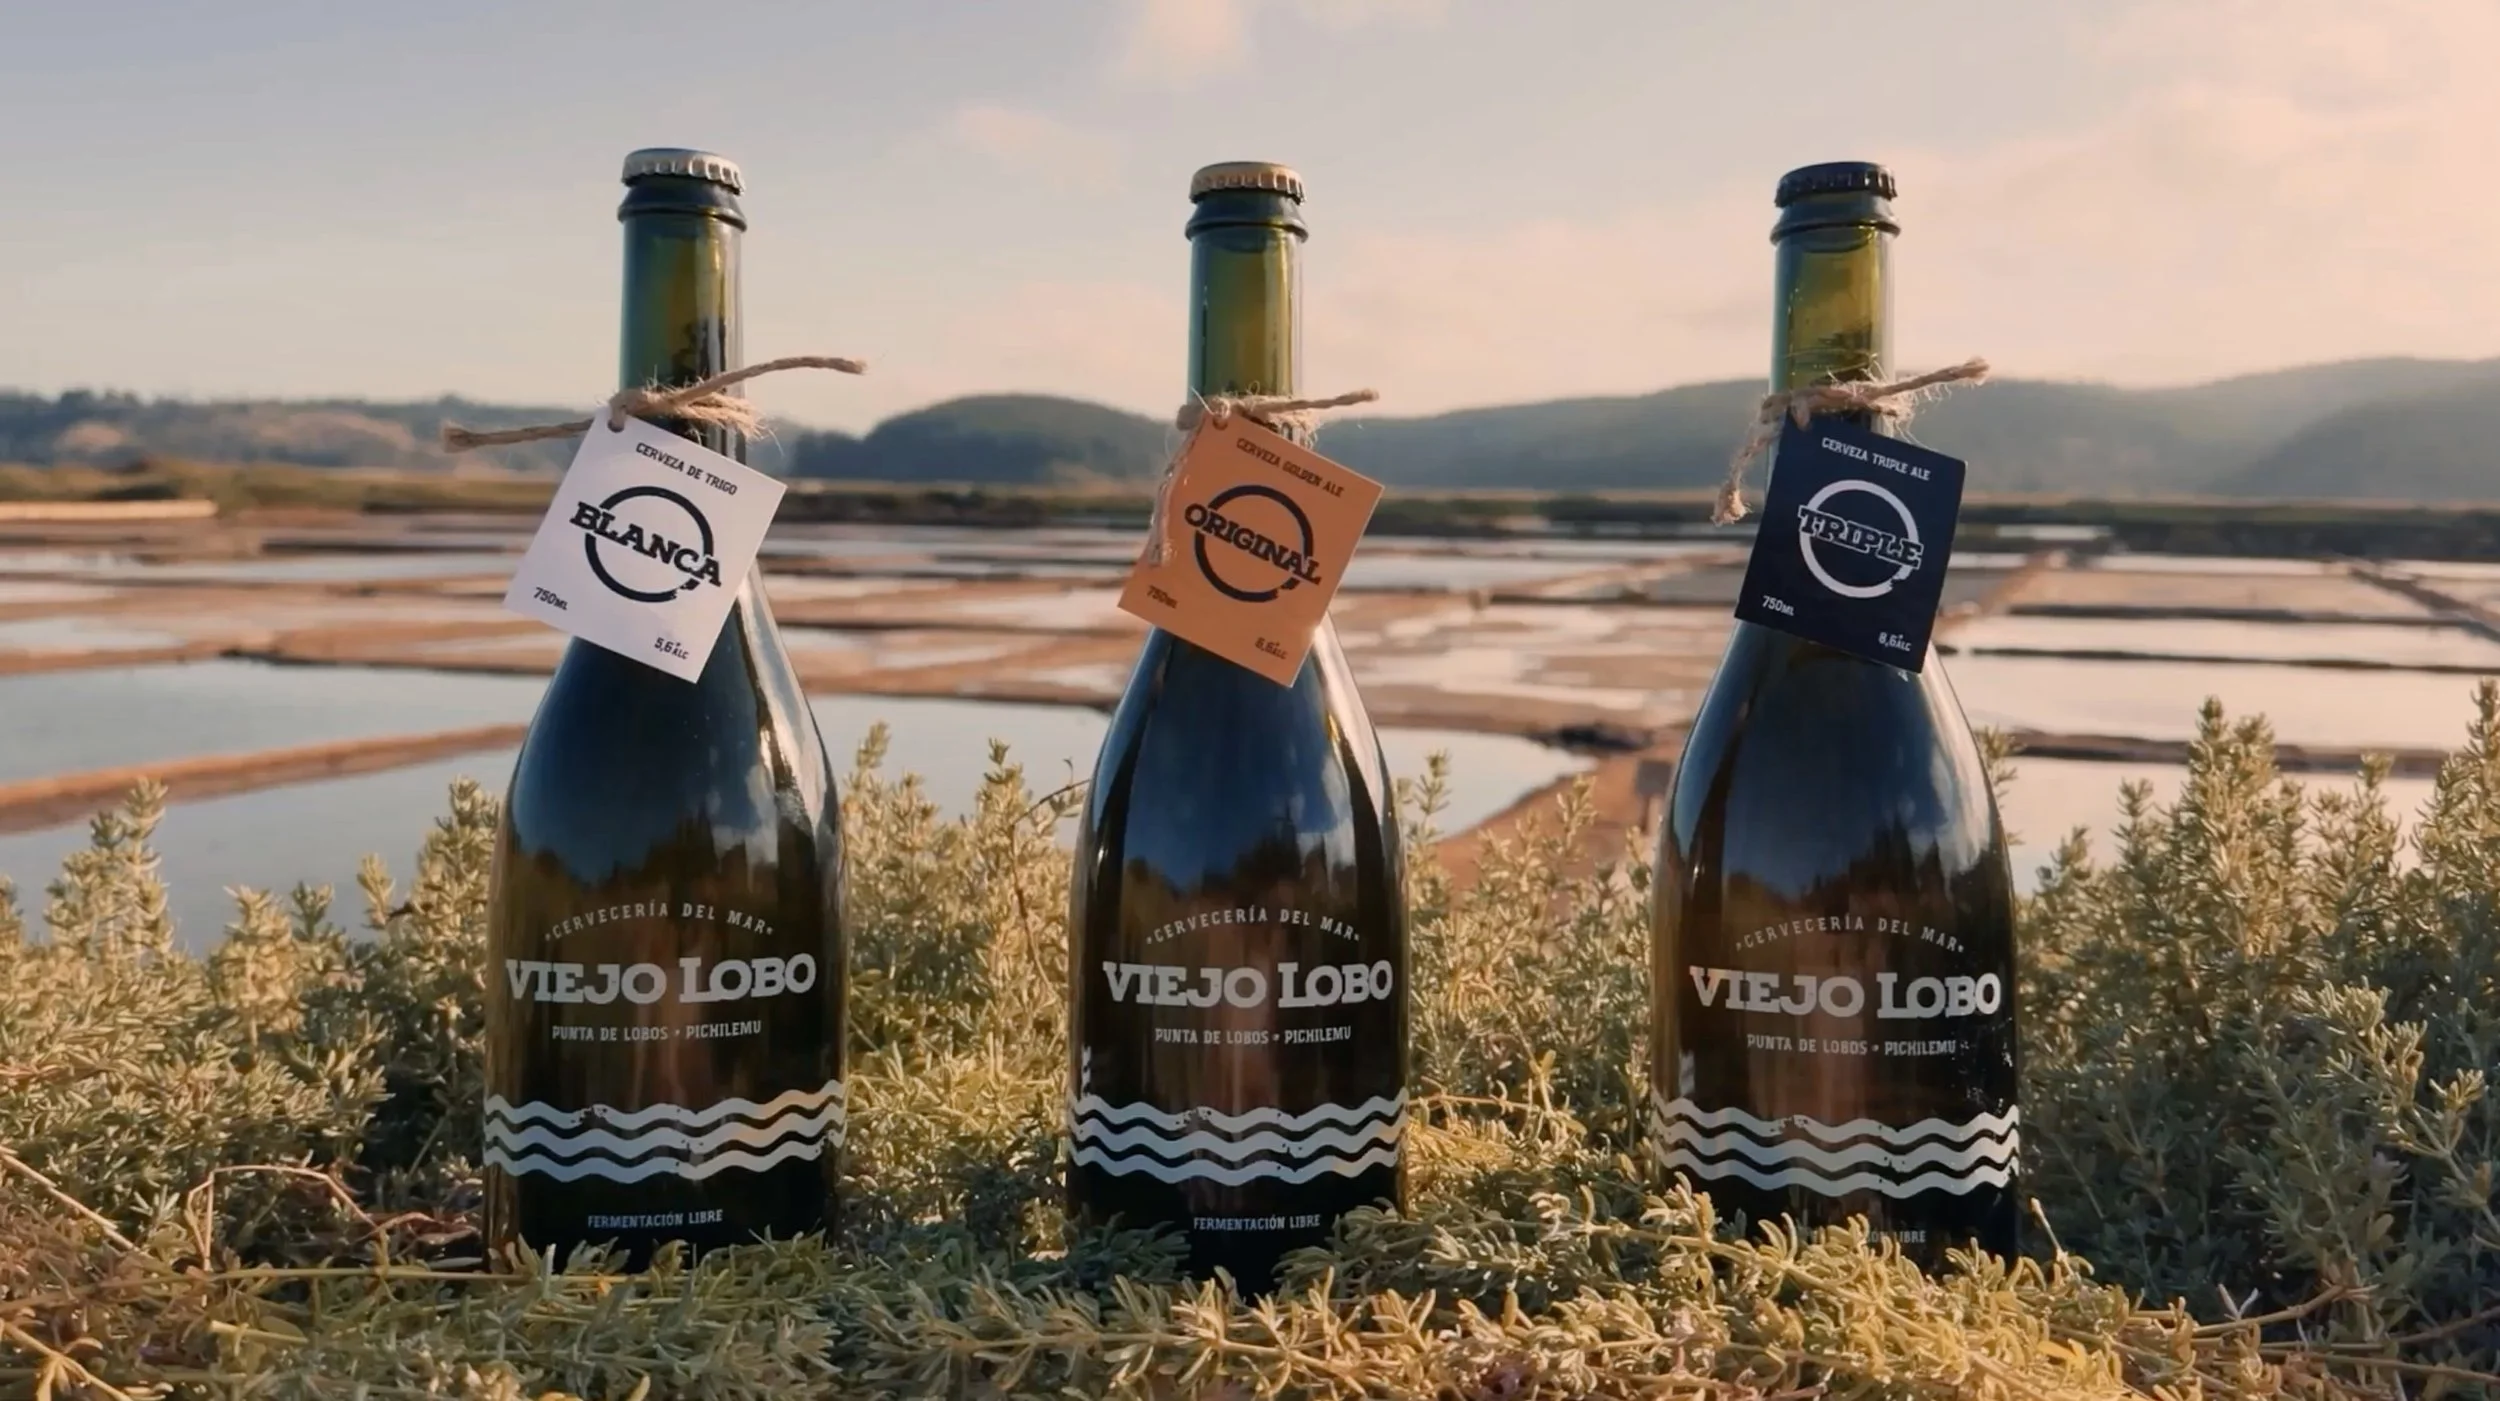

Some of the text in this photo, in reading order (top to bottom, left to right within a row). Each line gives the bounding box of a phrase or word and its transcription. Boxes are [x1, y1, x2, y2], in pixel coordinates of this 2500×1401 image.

[635, 442, 738, 496] CERVEZA DE TRIGO
[1236, 438, 1345, 498] CERVEZA GOLDEN ALE
[1822, 437, 1931, 481] CERVEZA TRIPLE ALE
[569, 501, 722, 587] BLANCA
[1184, 503, 1322, 585] ORIGINAL
[1797, 504, 1924, 570] TRIPLE
[552, 899, 766, 940] CERVECERÍA DEL MAR
[1154, 905, 1354, 943] CERVECERÍA DEL MAR
[1744, 913, 1958, 952] CERVECERÍA DEL MAR
[505, 953, 817, 1004] VIEJO LOBO
[1103, 959, 1393, 1008] VIEJO LOBO
[1689, 966, 2001, 1019] VIEJO LOBO
[552, 1020, 762, 1042] PUNTA DE LOBOS PICHILEMU
[1155, 1025, 1352, 1045] PUNTA DE LOBOS PICHILEMU
[1746, 1034, 1957, 1056] PUNTA DE LOBOS PICHILEMU
[587, 1209, 723, 1229] FERMENTACIÓN LIBRE
[1193, 1214, 1321, 1230] FERMENTACIÓN LIBRE
